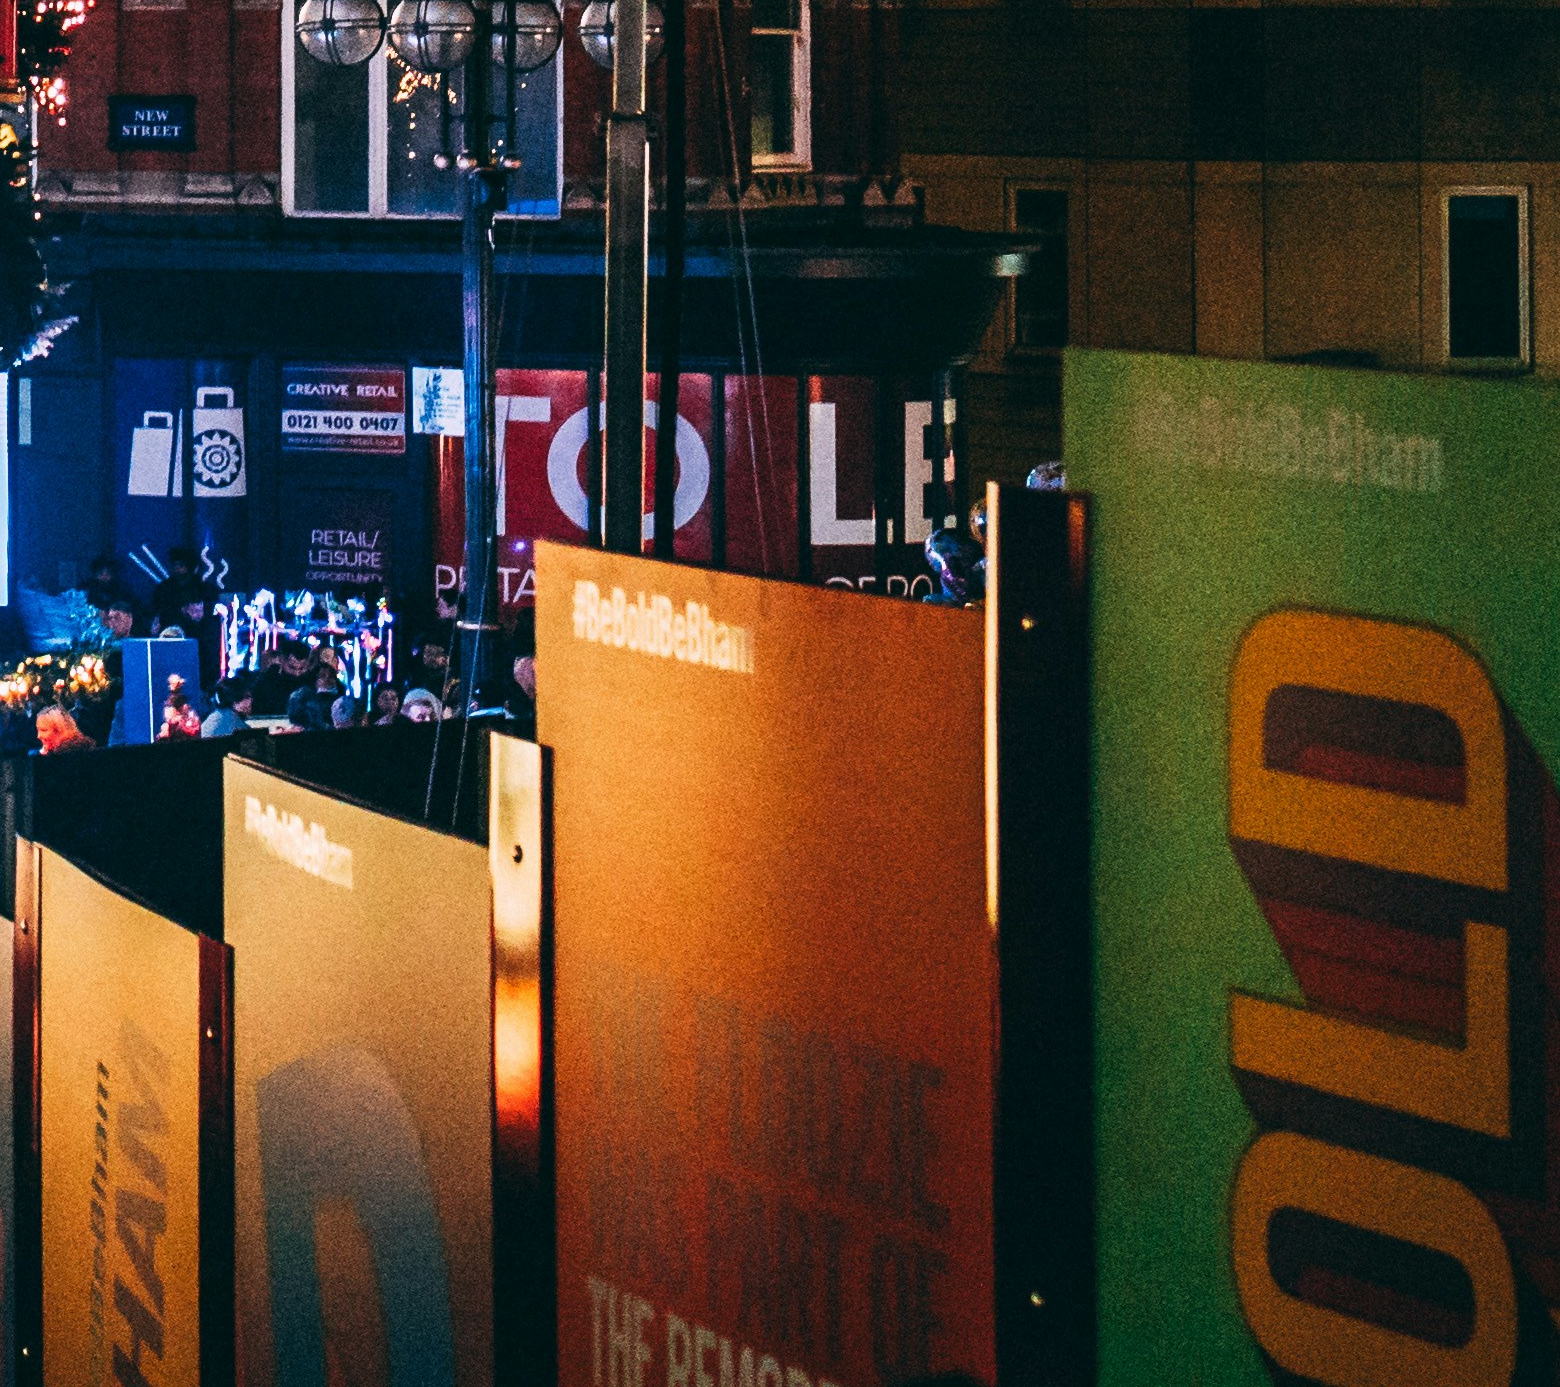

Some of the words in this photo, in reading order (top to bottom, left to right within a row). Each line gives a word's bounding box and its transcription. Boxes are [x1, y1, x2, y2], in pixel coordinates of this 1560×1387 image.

[134, 109, 169, 122] NEW
[121, 125, 182, 137] STREET
[286, 382, 350, 398] CREATIVE
[356, 384, 399, 399] RETAIL
[286, 414, 318, 429] 0121
[323, 415, 354, 430] 400
[359, 416, 399, 432] 0407
[311, 528, 381, 549] RETAIL/
[308, 548, 383, 568] LEISURE
